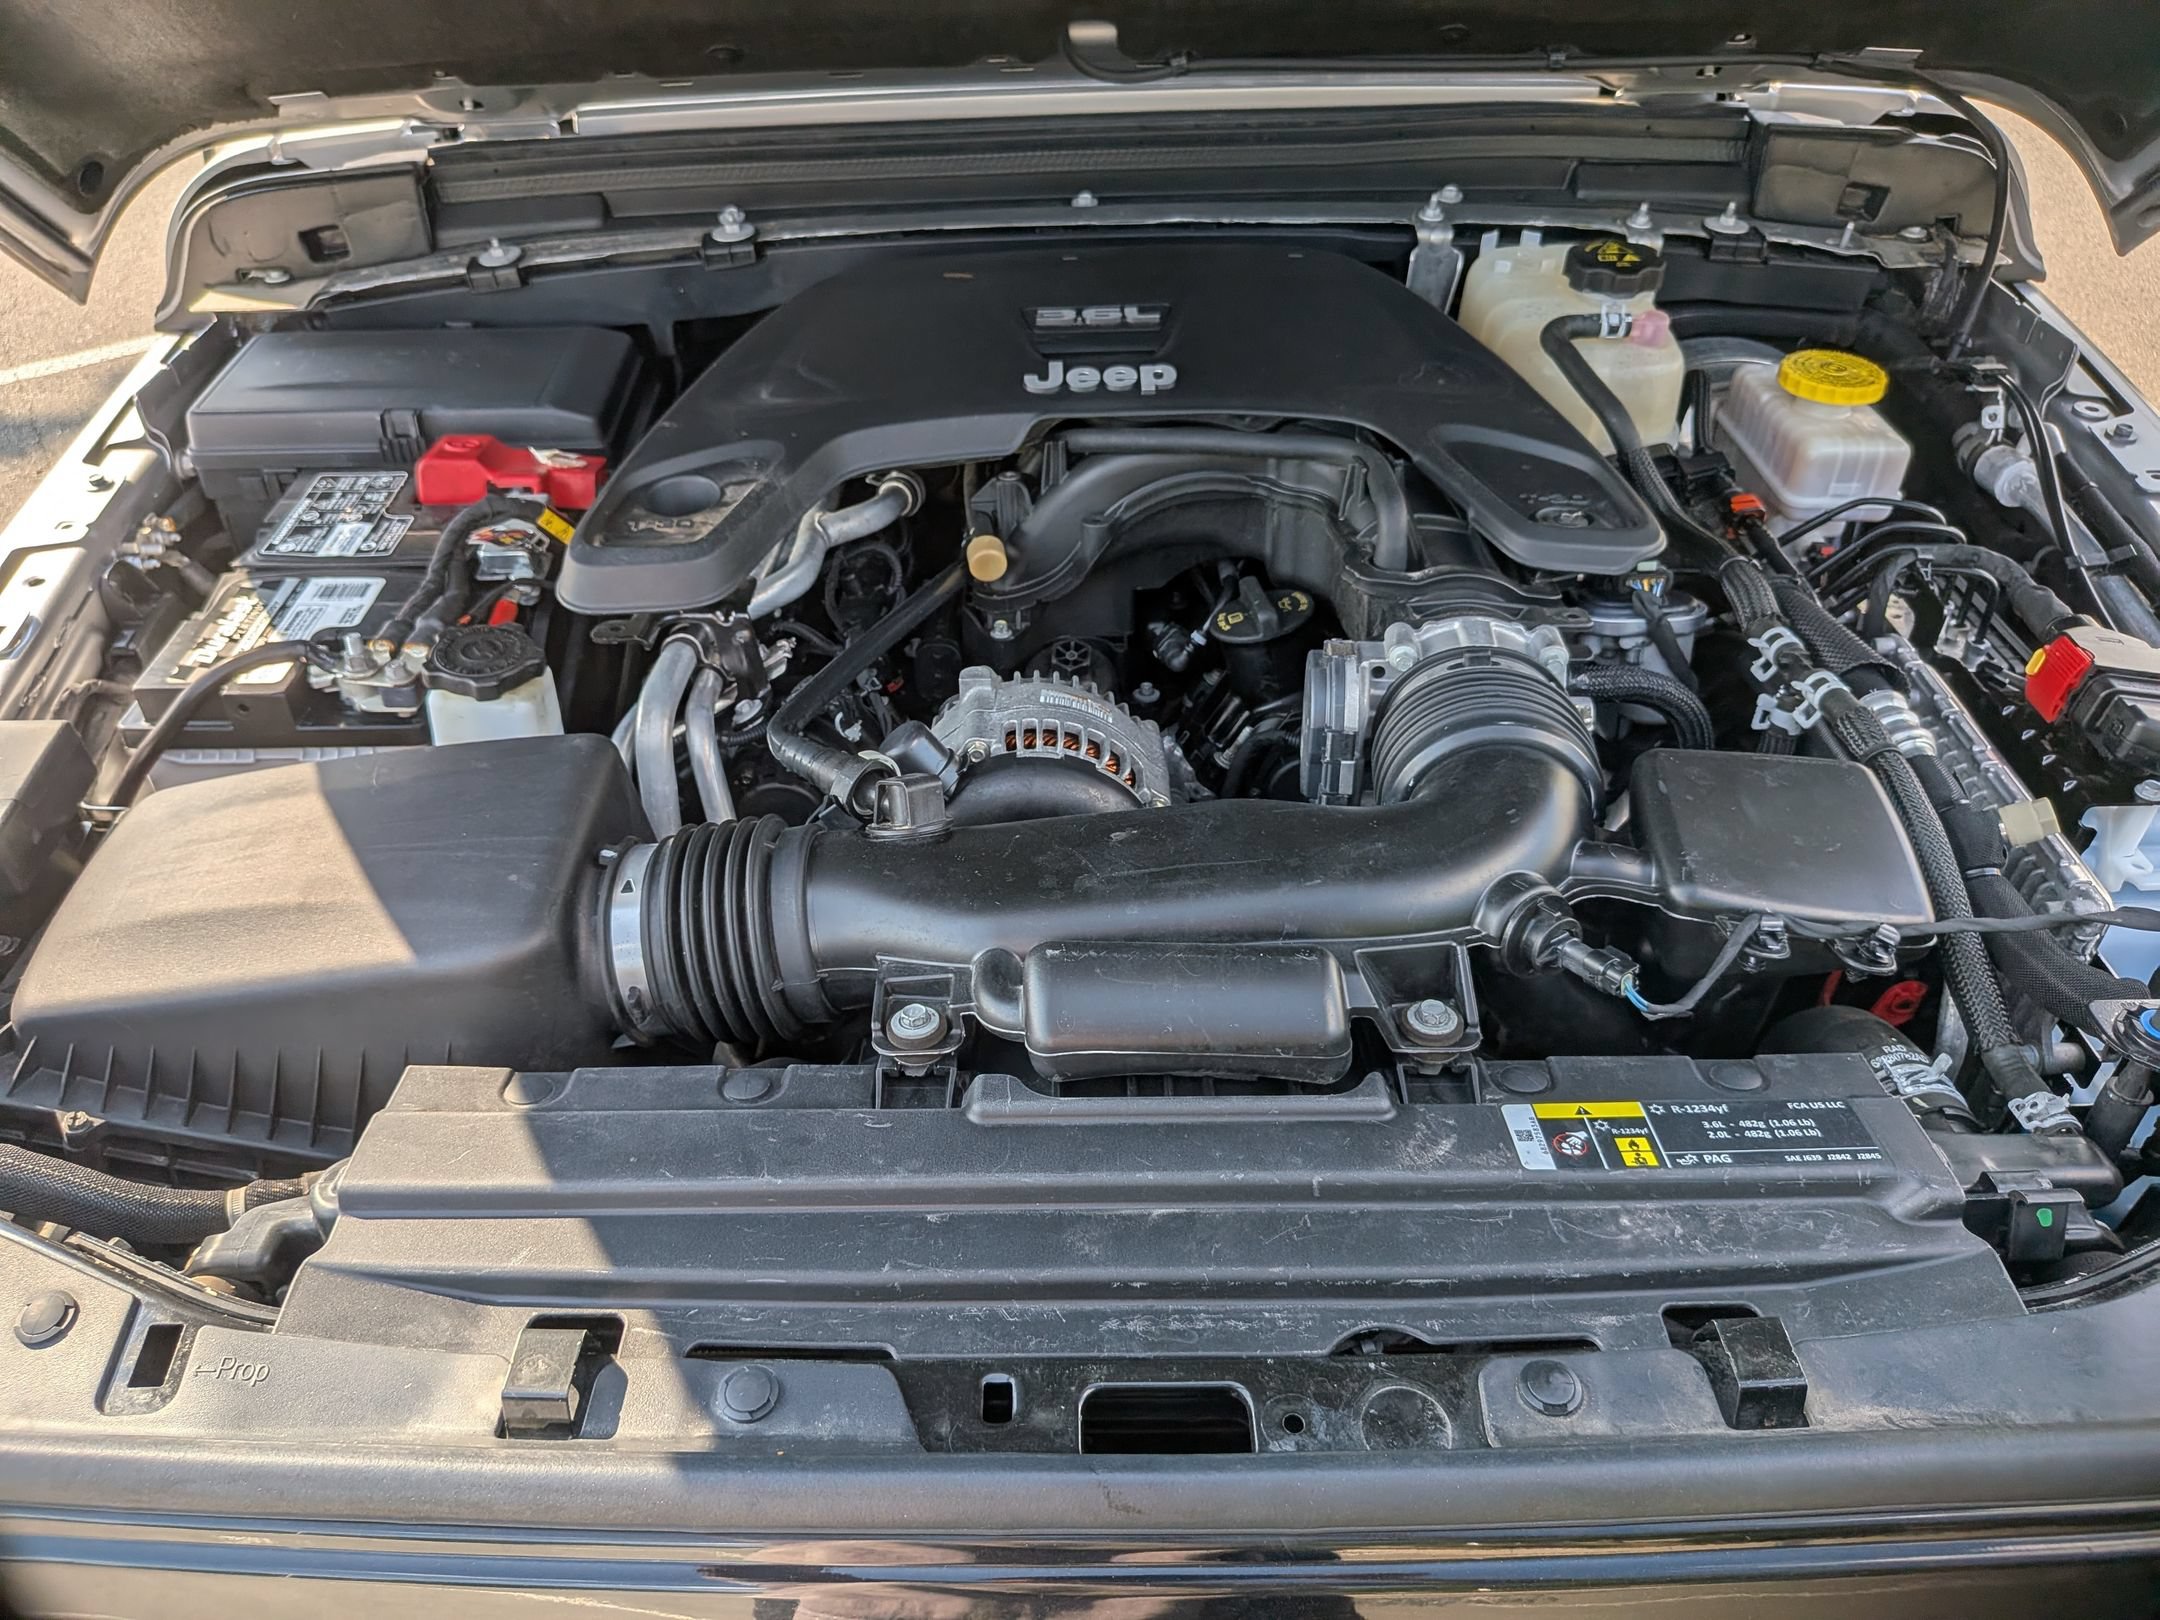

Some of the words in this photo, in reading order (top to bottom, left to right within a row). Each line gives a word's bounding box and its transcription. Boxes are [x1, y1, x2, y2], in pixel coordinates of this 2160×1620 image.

[1023, 360, 1178, 395] Jeep
[1881, 1044, 1907, 1054] RAD
[1670, 1103, 1730, 1115] R-1234yf
[1786, 1101, 1809, 1110] FCA
[1809, 1101, 1825, 1109] US
[1825, 1101, 1846, 1109] LLC
[1702, 1120, 1727, 1129] 3.6L
[1738, 1120, 1767, 1129] 482g
[1768, 1119, 1797, 1129] (1.06
[1797, 1118, 1817, 1128] Lb)
[1611, 1127, 1649, 1135] R-1234yf
[1706, 1130, 1732, 1139] 2.0L
[1744, 1130, 1773, 1139] 482g
[1774, 1129, 1803, 1138] (1.06
[1803, 1128, 1823, 1138] Lb)
[1703, 1154, 1734, 1164] PAG
[1784, 1154, 1803, 1162] SAE
[216, 1356, 271, 1388] Prop
